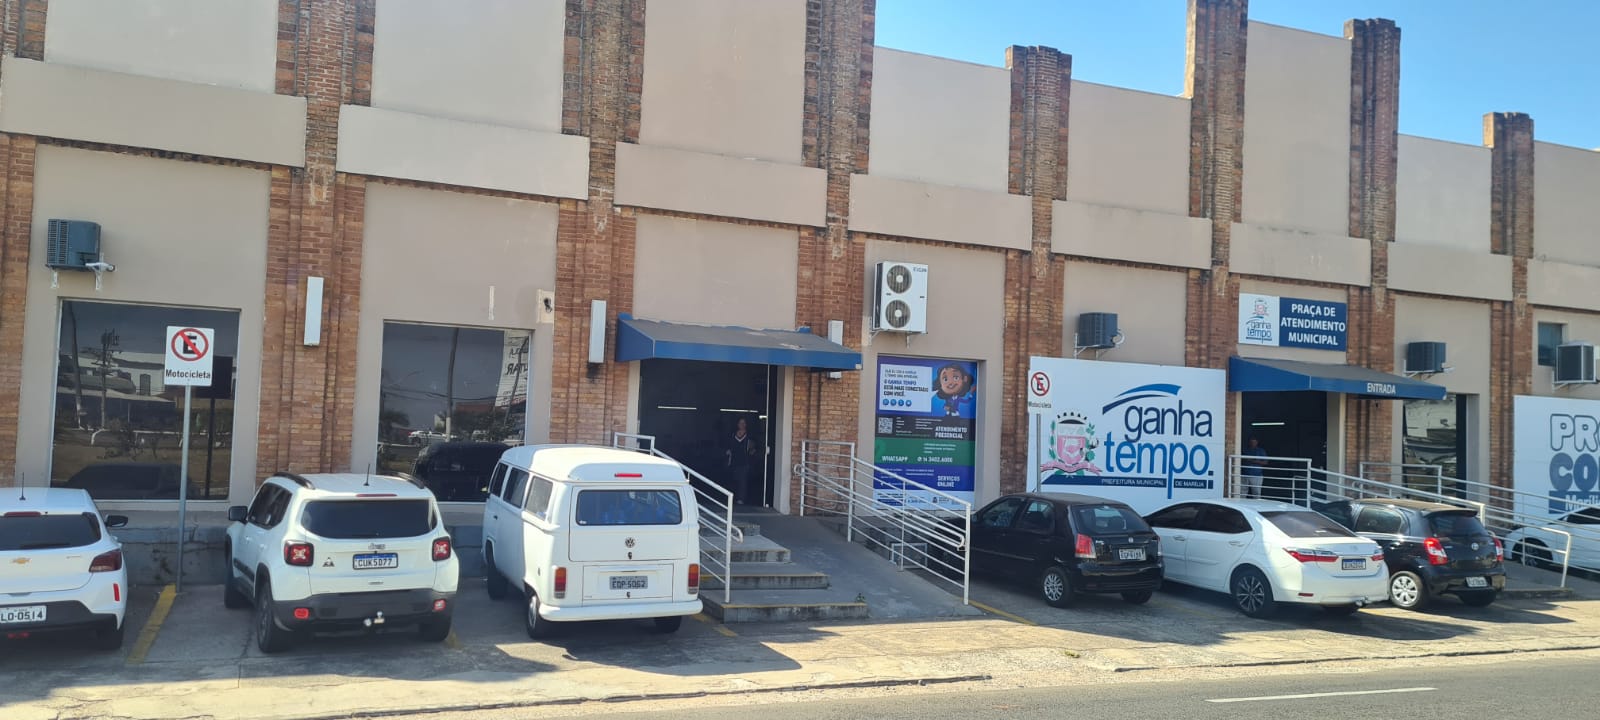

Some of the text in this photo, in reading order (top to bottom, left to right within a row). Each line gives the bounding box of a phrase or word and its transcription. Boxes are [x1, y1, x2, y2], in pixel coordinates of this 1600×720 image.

[1291, 303, 1336, 317] PRAÇA DE
[1280, 316, 1346, 332] ATENDIMENTO
[1288, 332, 1339, 346] MUNICIPAL
[165, 369, 211, 379] Motocicleta
[1367, 382, 1396, 395] ENTRADA
[1124, 399, 1213, 443] ganha
[1549, 413, 1600, 453] PR
[1549, 452, 1600, 492] CO
